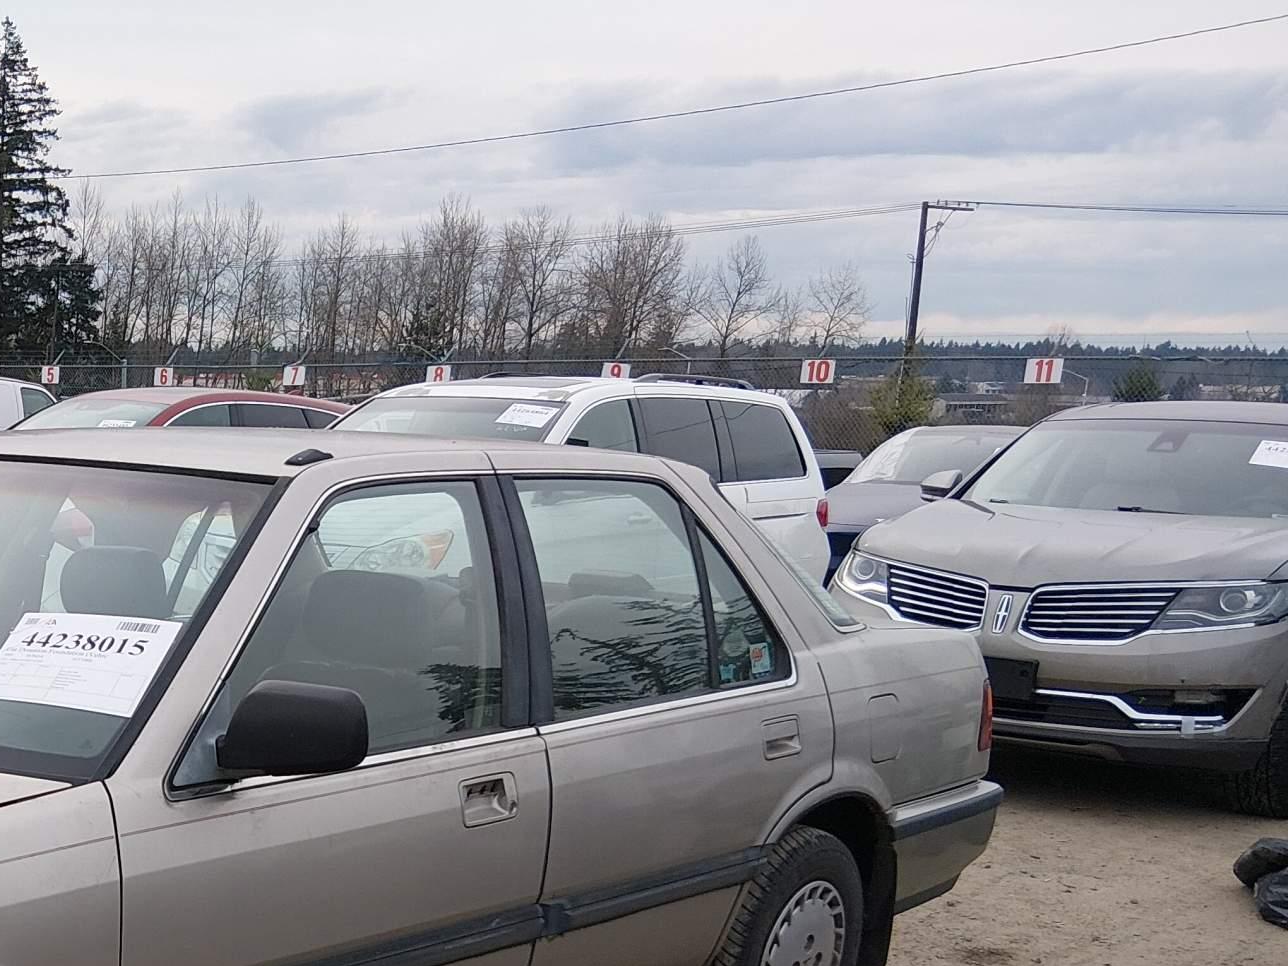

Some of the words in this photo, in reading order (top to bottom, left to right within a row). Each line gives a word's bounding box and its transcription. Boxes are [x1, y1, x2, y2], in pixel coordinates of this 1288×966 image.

[47, 367, 54, 383] 5
[159, 368, 168, 385] 6
[291, 367, 299, 385] 7
[433, 366, 444, 382] 8
[610, 364, 621, 378] 9
[807, 360, 831, 383] 10
[1035, 359, 1054, 383] 11
[21, 631, 150, 656] 44238015
